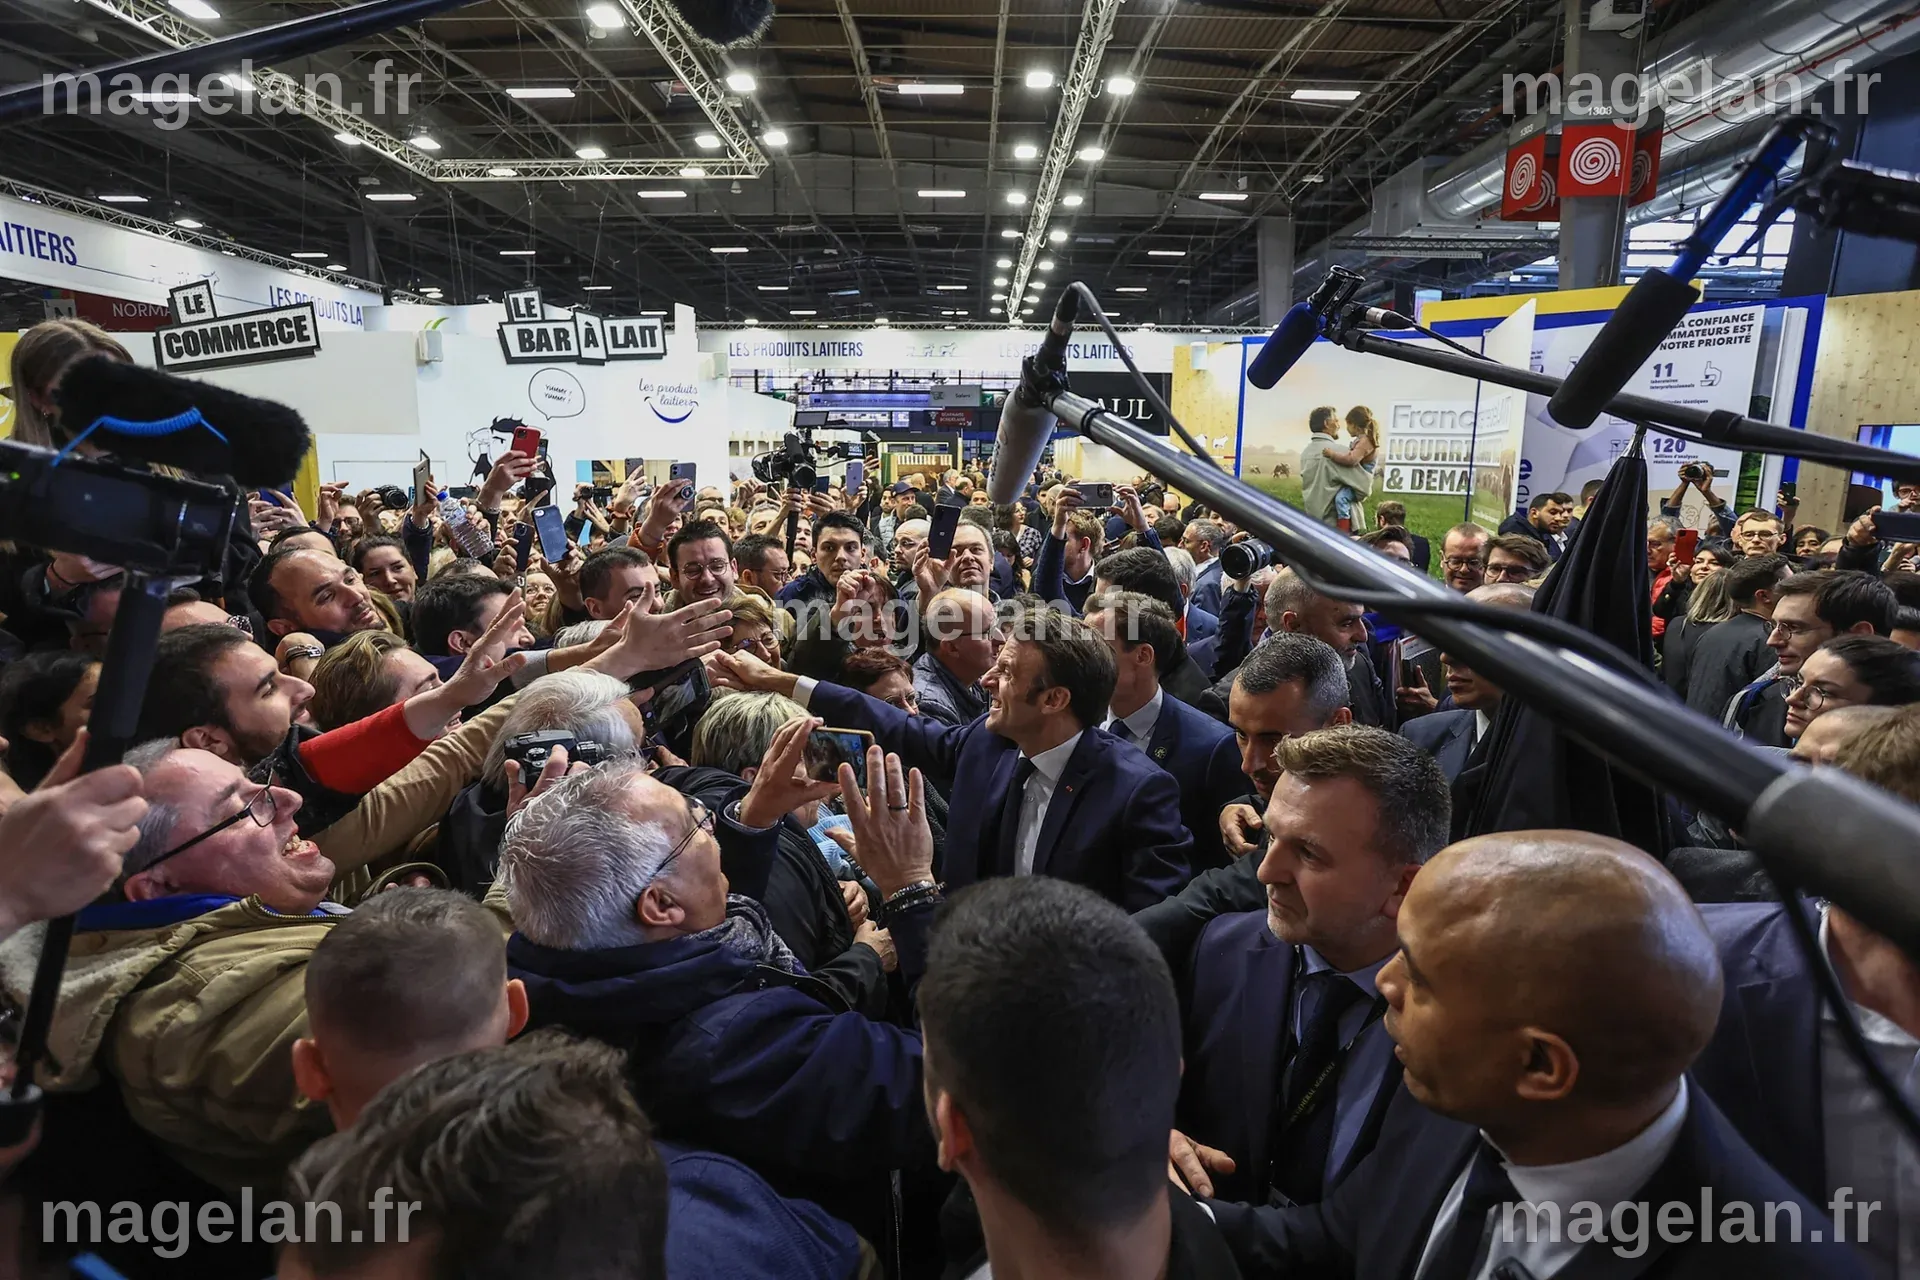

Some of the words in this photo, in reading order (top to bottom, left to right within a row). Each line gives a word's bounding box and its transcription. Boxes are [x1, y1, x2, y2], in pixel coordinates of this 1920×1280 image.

[182, 293, 207, 315] LE
[512, 296, 538, 318] LE
[1688, 313, 1755, 328] CONFIANCE
[1733, 324, 1754, 334] EST
[163, 314, 311, 359] COMMERCE
[517, 327, 572, 353] BAR
[584, 321, 599, 348] À
[609, 325, 658, 348] LAIT
[1660, 340, 1695, 351] NOTRE
[1697, 332, 1752, 348] PRIORITÉ
[729, 341, 750, 357] LES
[753, 341, 809, 357] PRODUITS
[812, 341, 864, 357] LAITIERS
[999, 342, 1020, 358] LES
[1024, 343, 1080, 359] PRTS
[1083, 343, 1134, 360] LAITIES
[1653, 362, 1674, 378] 11
[639, 377, 654, 391] Les
[656, 383, 698, 396] produits
[660, 394, 694, 407] laitiers
[1653, 438, 1686, 453] 120
[1386, 467, 1403, 490] &
